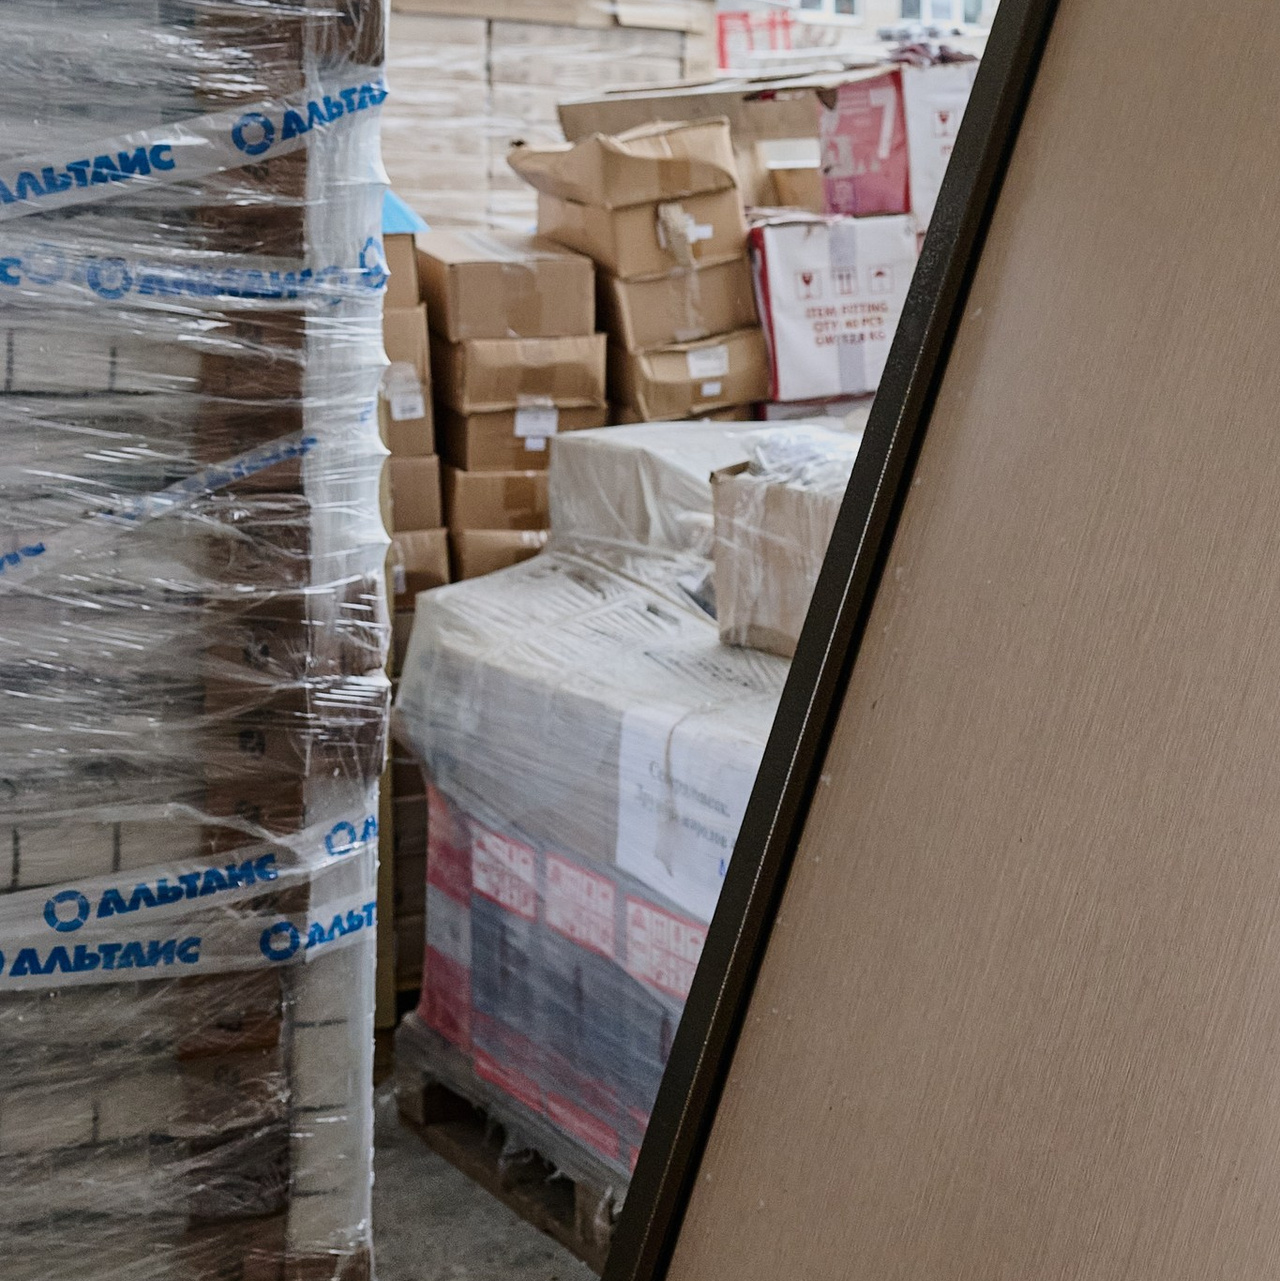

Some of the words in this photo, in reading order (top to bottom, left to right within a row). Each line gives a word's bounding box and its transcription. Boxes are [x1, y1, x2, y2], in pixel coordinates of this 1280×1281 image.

[280, 80, 389, 141] АЛЬТА
[96, 853, 278, 918] АЛЬТАИС
[9, 936, 202, 977] АЛЬТАИС
